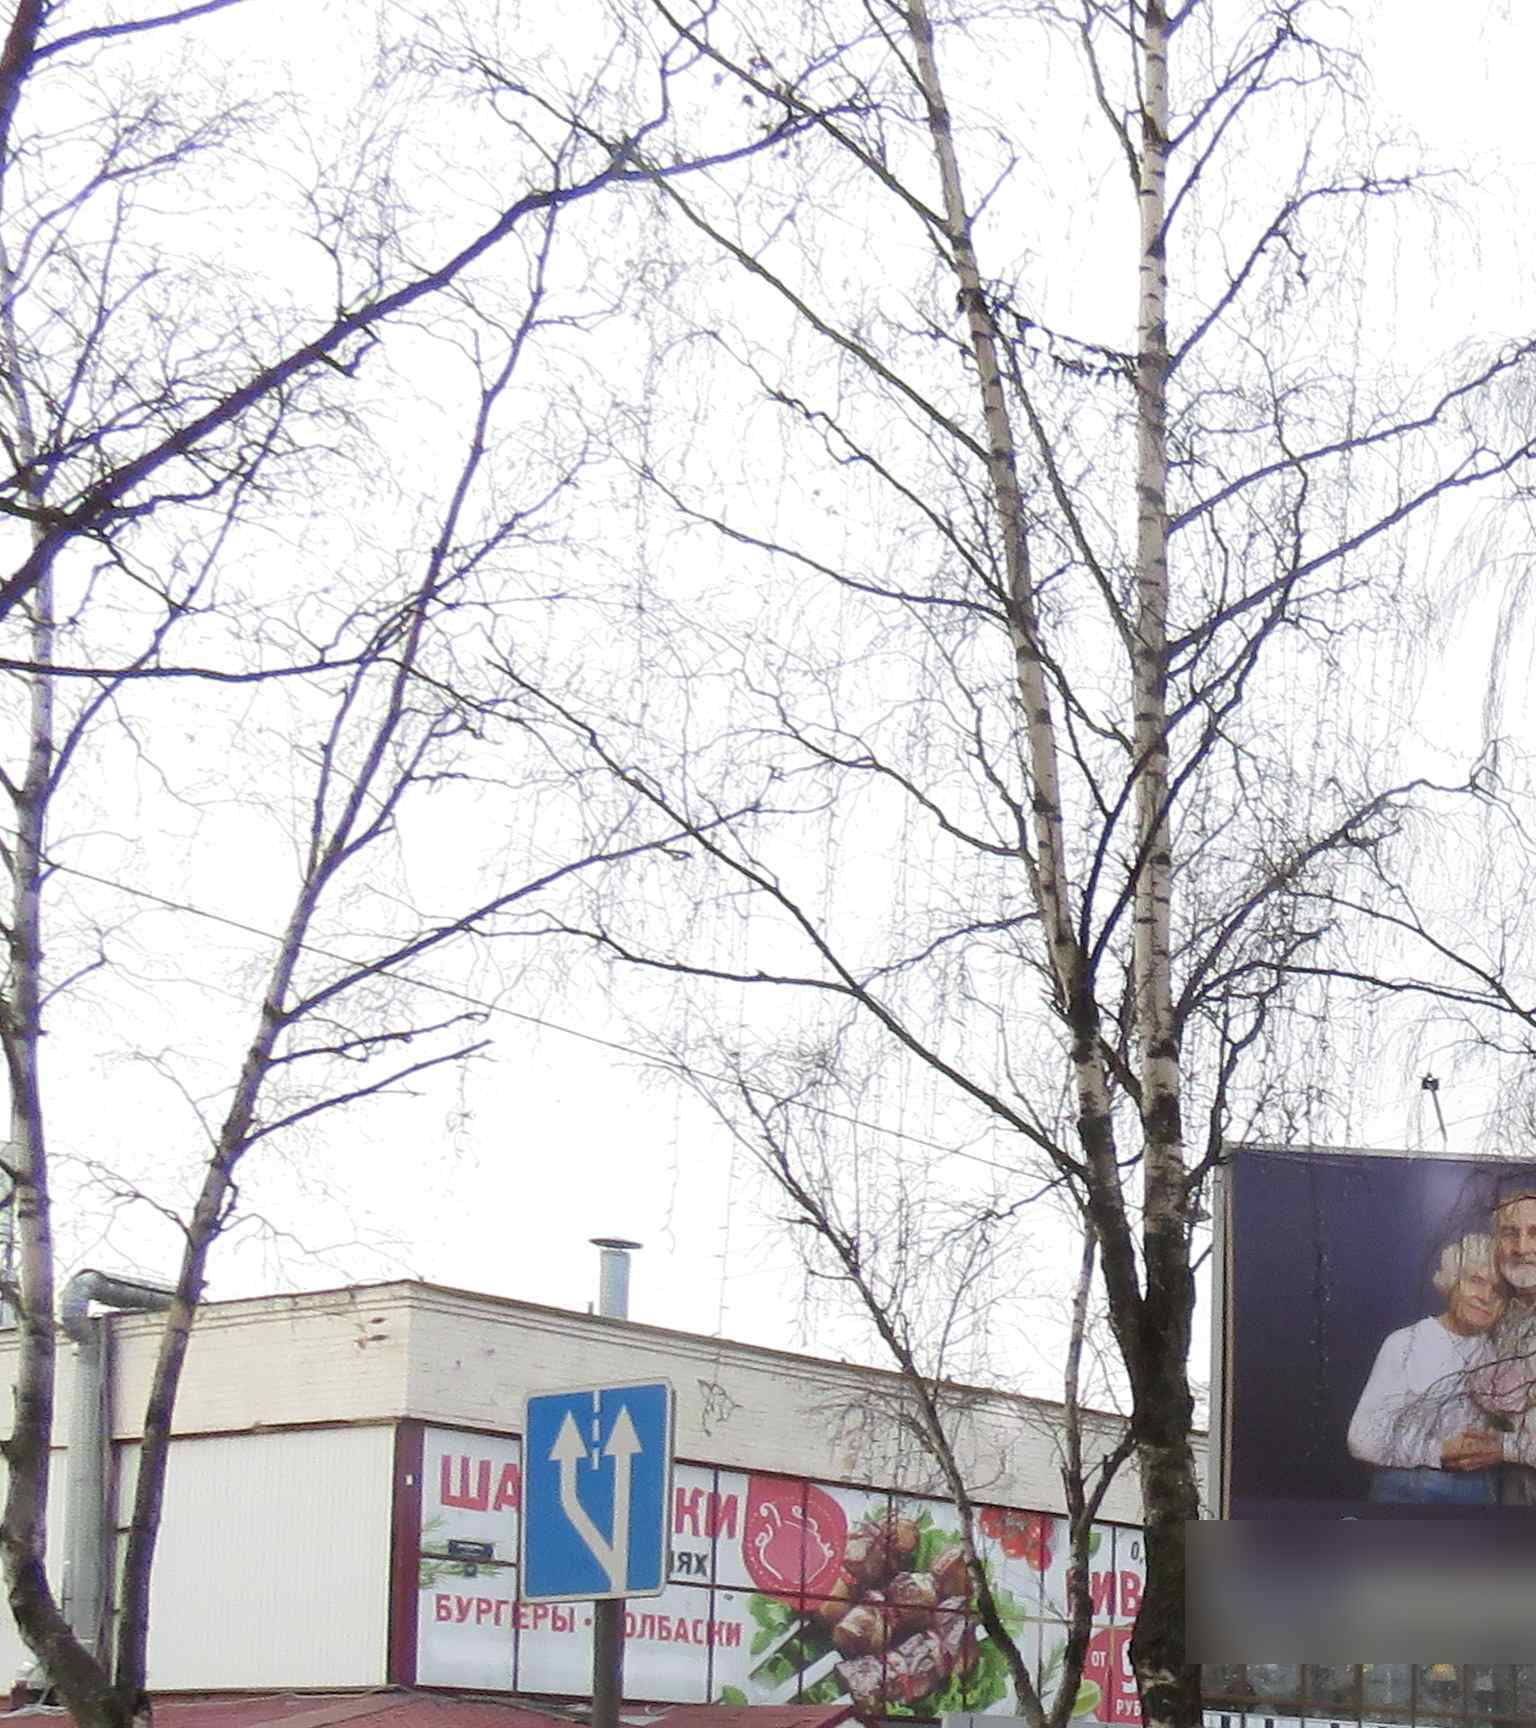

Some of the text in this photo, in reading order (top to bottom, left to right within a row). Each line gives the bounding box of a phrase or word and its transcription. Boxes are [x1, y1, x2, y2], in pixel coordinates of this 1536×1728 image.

[440, 1454, 739, 1541] ШАКИ
[434, 1594, 742, 1648] БУРГЕРЫ ОЛБАСКИ
[1090, 1650, 1107, 1668] ОТ
